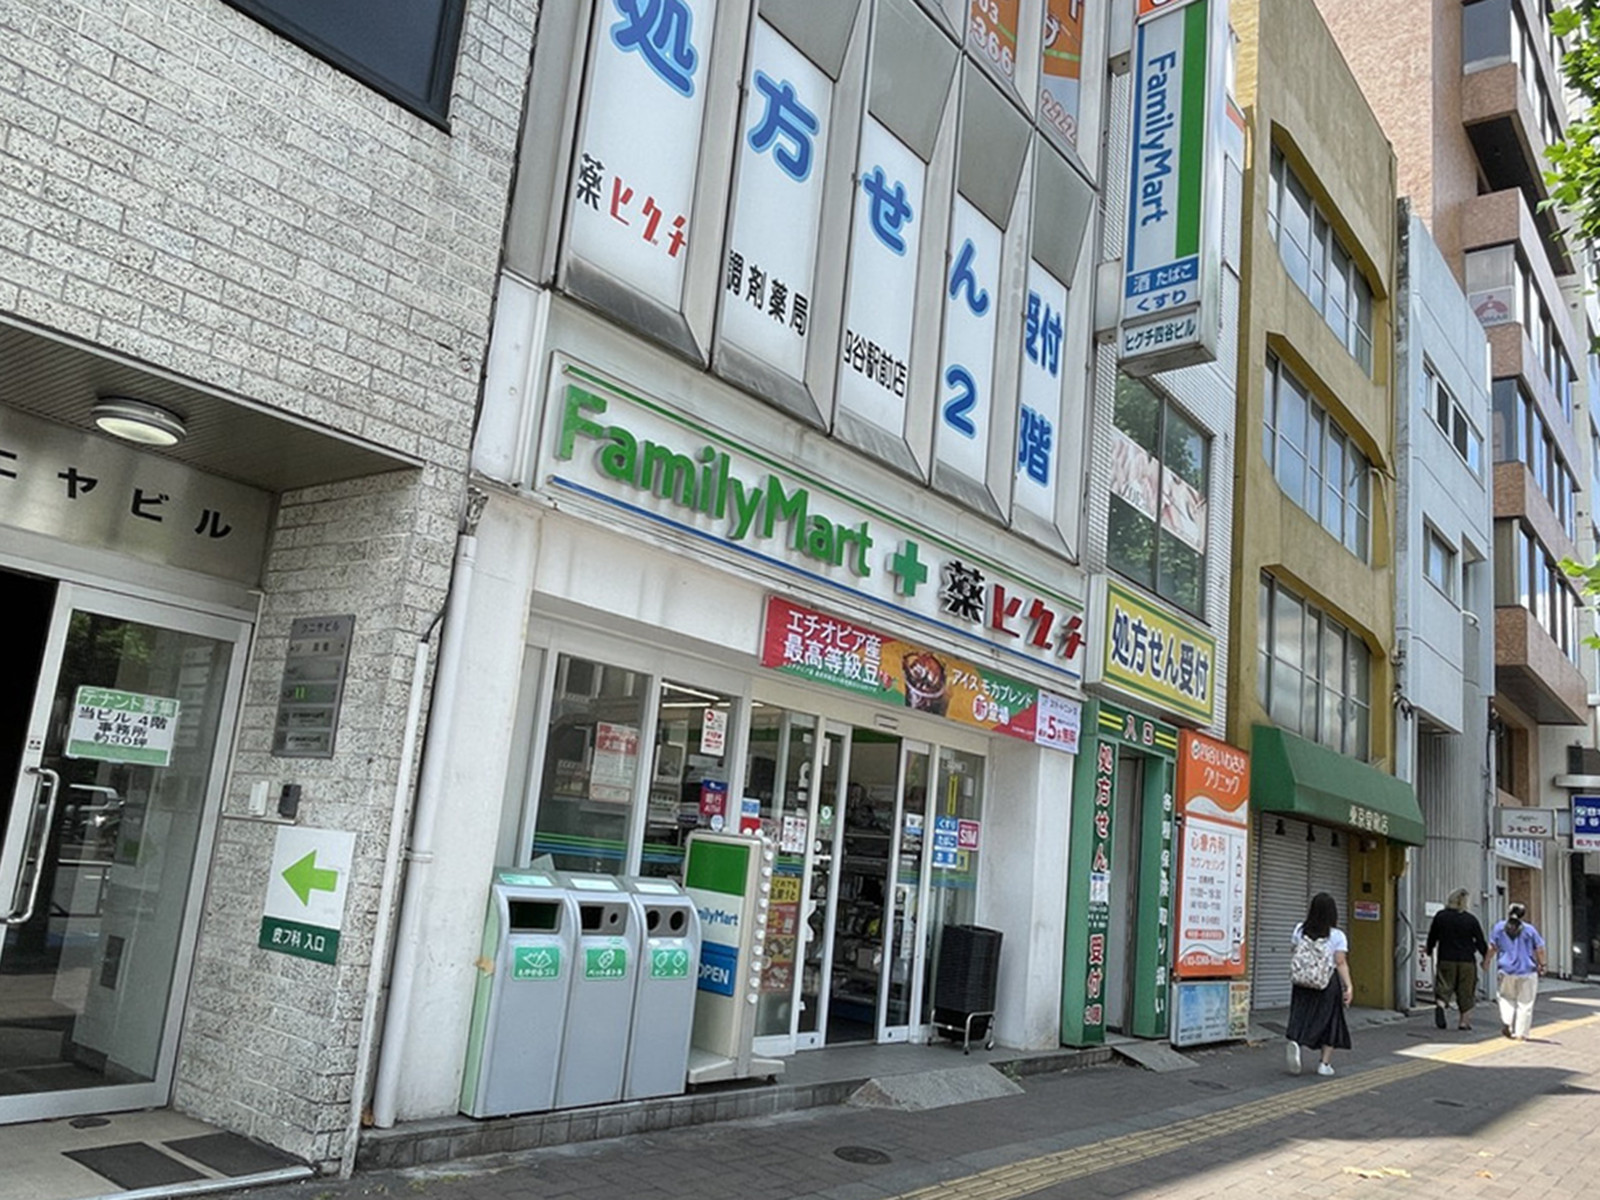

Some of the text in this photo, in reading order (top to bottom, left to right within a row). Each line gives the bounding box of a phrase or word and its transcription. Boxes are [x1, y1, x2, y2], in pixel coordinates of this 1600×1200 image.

[1140, 50, 1177, 228] FamilyMart
[748, 69, 819, 182] 方
[861, 164, 914, 256] せ
[949, 238, 990, 317] ん
[1132, 263, 1192, 293] 酒 たばこ
[1136, 289, 1187, 311] くすり
[554, 384, 875, 579] FamilyMart
[786, 609, 882, 661] エチオピア産
[783, 633, 880, 686] 最高等級豆
[1112, 607, 1210, 701] 処方せん受付
[78, 706, 132, 724] 当ビル
[98, 721, 148, 738] 事務所
[1123, 713, 1154, 746] 入口
[93, 732, 148, 748] 約30坪
[304, 933, 325, 952] 入口
